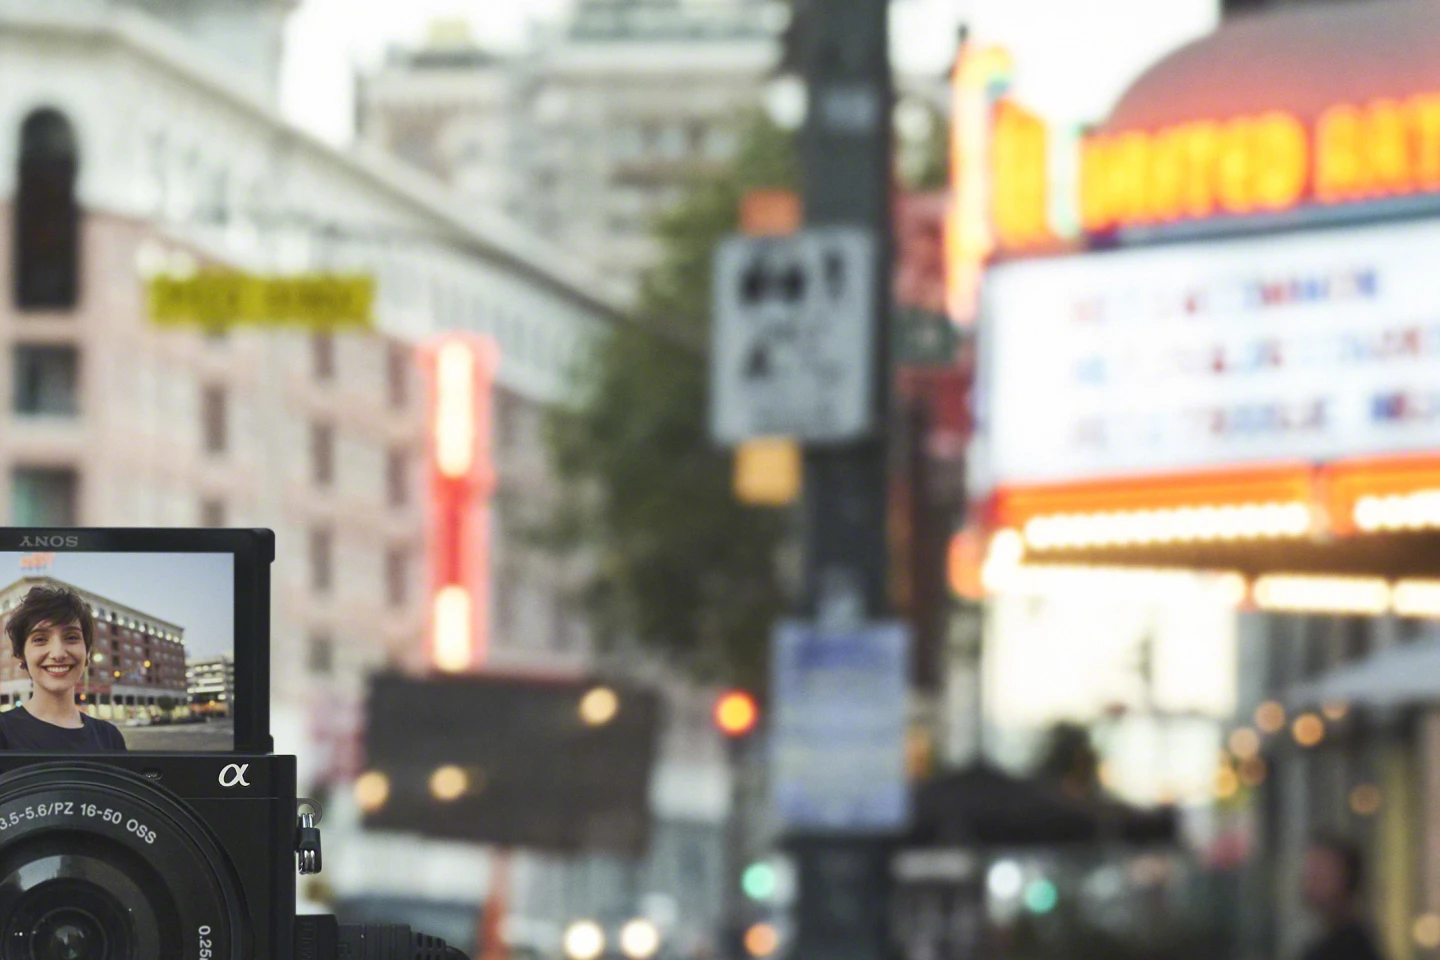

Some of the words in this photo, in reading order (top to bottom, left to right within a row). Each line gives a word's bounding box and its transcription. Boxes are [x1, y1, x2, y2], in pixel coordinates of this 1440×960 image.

[19, 535, 79, 547] SONY
[80, 803, 122, 824] 16-50
[126, 818, 157, 844] OSS
